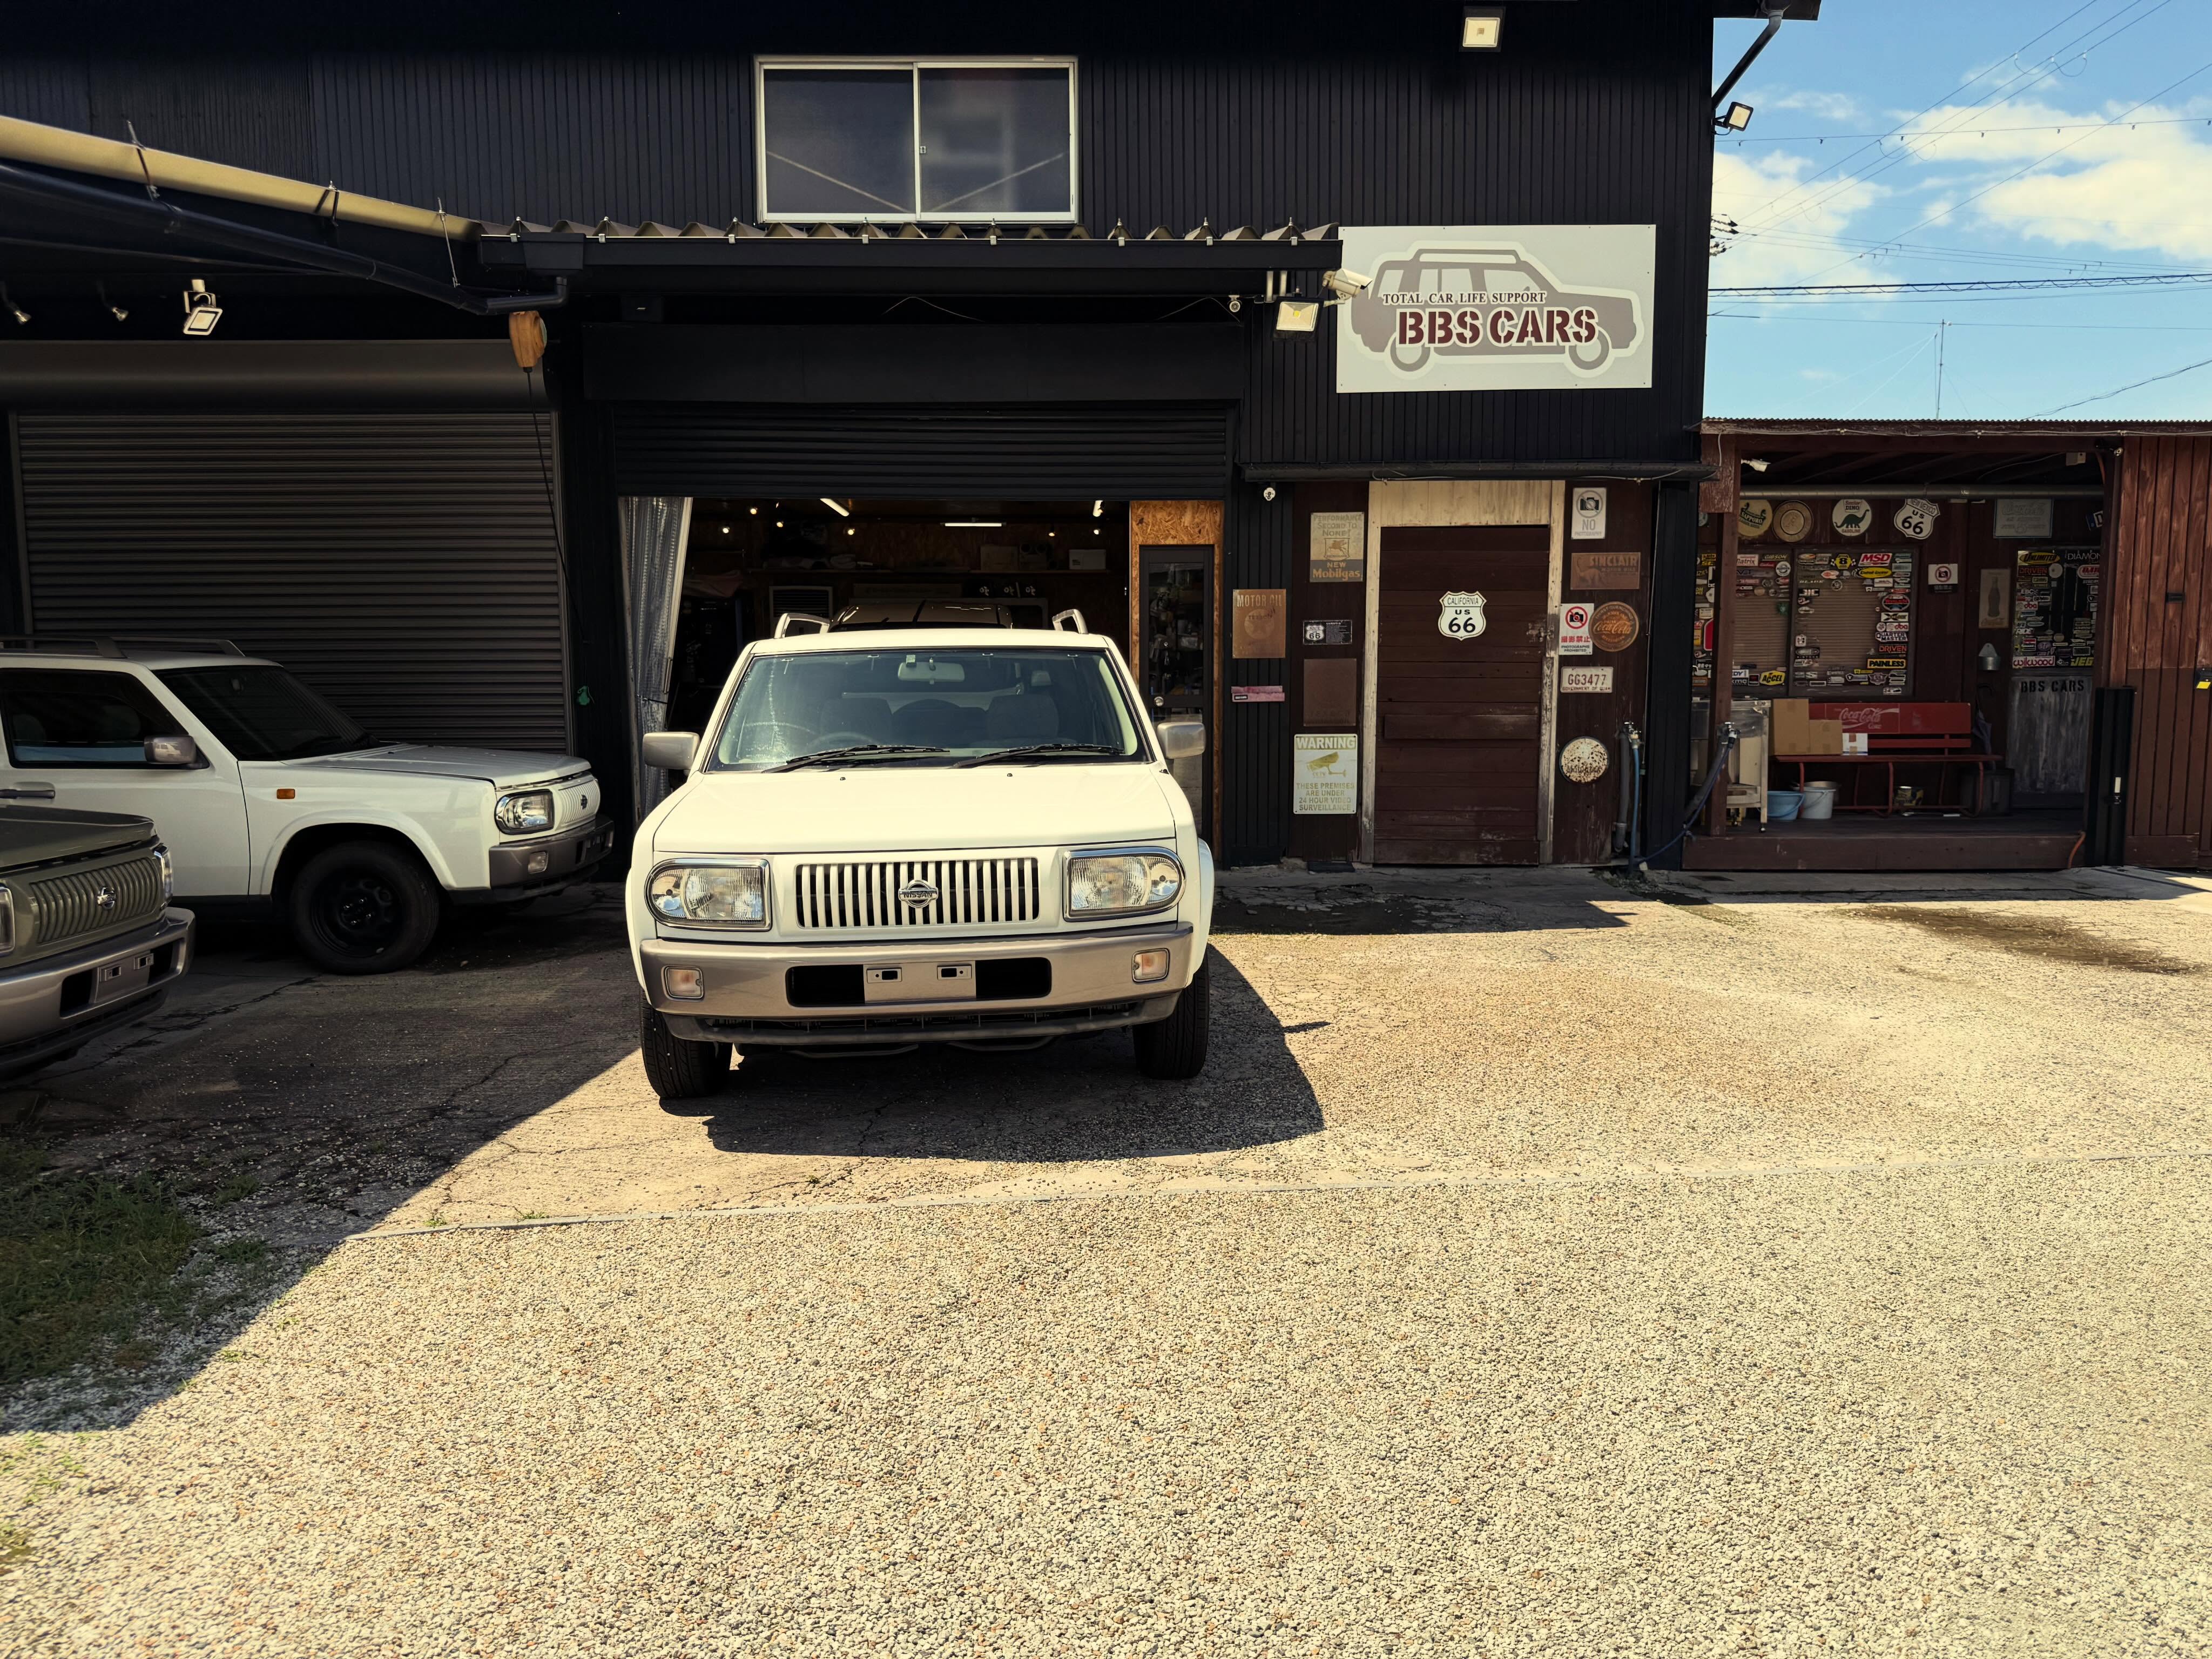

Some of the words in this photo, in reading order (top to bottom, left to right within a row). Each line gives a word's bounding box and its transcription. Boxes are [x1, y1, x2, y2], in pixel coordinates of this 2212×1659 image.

[1383, 293, 1423, 304] TOTAL
[1429, 293, 1454, 304] CAR
[1460, 293, 1486, 304] LIFE
[1492, 292, 1547, 304] SUPPORT
[1398, 309, 1481, 345] BBS
[1489, 309, 1596, 345] CARS
[1313, 514, 1362, 522] PERFORMANCE
[1912, 510, 1925, 518] US
[1582, 519, 1596, 530] NO
[1901, 516, 1924, 535] 66
[1589, 556, 1638, 567] SINCLAIR
[1861, 554, 1891, 562] MSD
[1313, 569, 1361, 581] Mobilgas
[1237, 595, 1266, 608] MOTOR
[1270, 595, 1282, 606] OIL
[1447, 597, 1479, 605] CALIFORNIA
[1448, 617, 1476, 633] 66
[2013, 656, 2054, 666] wilwood
[1568, 673, 1607, 686] GG3477
[1762, 675, 1783, 683] ACCEL
[2021, 681, 2045, 692] BBS
[2052, 680, 2084, 692] CARS
[1839, 707, 1882, 723] Coca-Cola
[1296, 737, 1356, 750] WARNING
